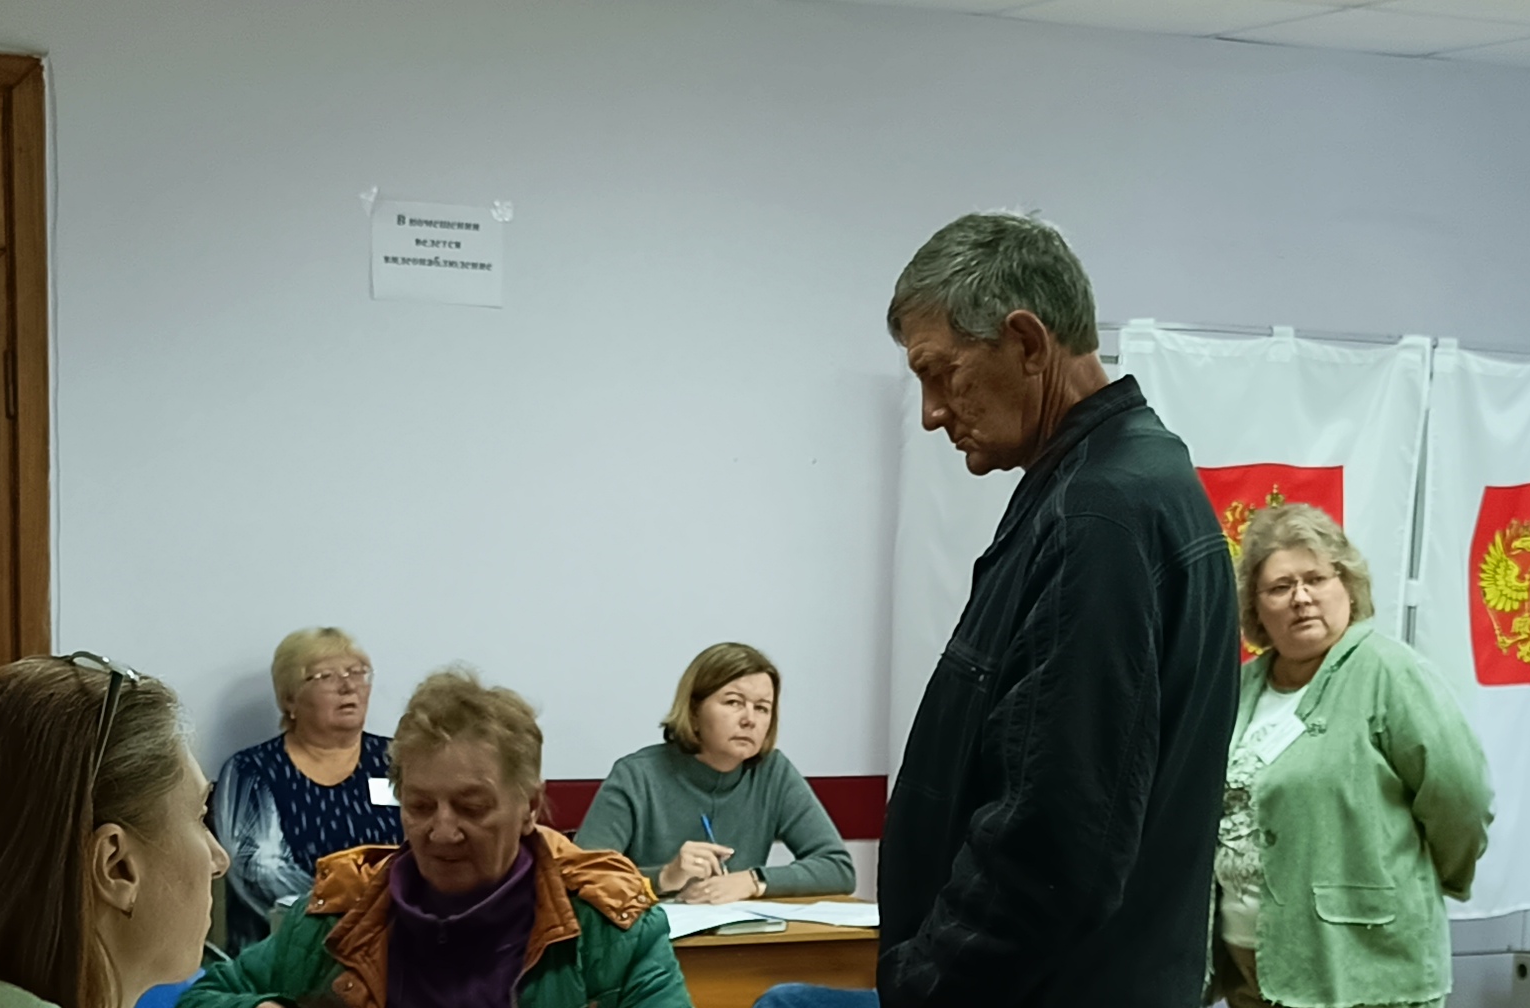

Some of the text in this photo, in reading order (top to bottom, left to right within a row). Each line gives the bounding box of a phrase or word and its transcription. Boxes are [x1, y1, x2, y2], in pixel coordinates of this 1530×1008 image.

[396, 214, 480, 232] В помещении
[415, 237, 462, 250] ведется
[383, 254, 493, 272] видеонаблюдение
